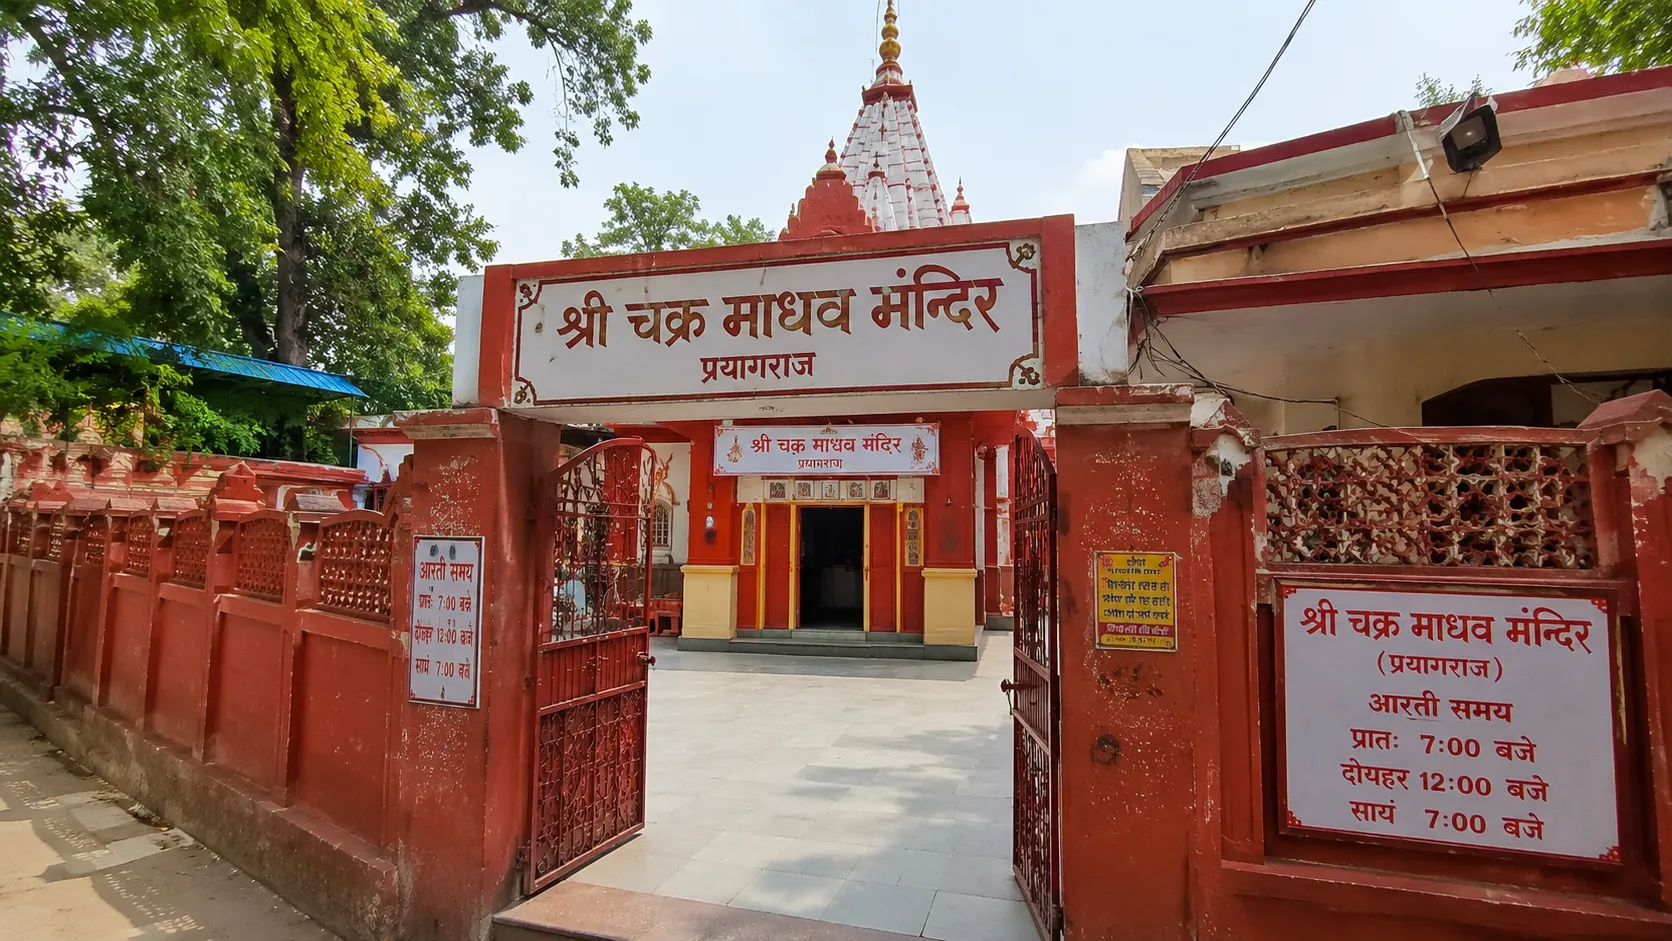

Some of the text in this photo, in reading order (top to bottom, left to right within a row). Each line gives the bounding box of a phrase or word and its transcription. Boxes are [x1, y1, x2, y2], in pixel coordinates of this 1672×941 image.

[557, 290, 613, 349] श्री
[625, 299, 709, 348] चक्र
[722, 288, 858, 340] माधव
[699, 351, 817, 385] प्रयागराज
[750, 433, 773, 453] श्री
[811, 437, 857, 453] माधव
[861, 432, 903, 455] मंदिर
[419, 555, 475, 583] आरती समय
[438, 594, 456, 612] 7:00
[436, 627, 457, 645] 12:00
[1300, 598, 1338, 637] श्री
[1345, 609, 1402, 641] चक्र
[1409, 611, 1496, 645] माधव
[436, 660, 455, 678] 7:00
[1377, 650, 1503, 683] (प्रयागराज)
[1368, 690, 1514, 723] आरती समय
[1350, 728, 1537, 764] प्रातः 7:00 बजे
[1419, 771, 1492, 797] 12:00
[1504, 774, 1550, 802] बजे
[1349, 798, 1545, 841] सायं 7:00 बजे
